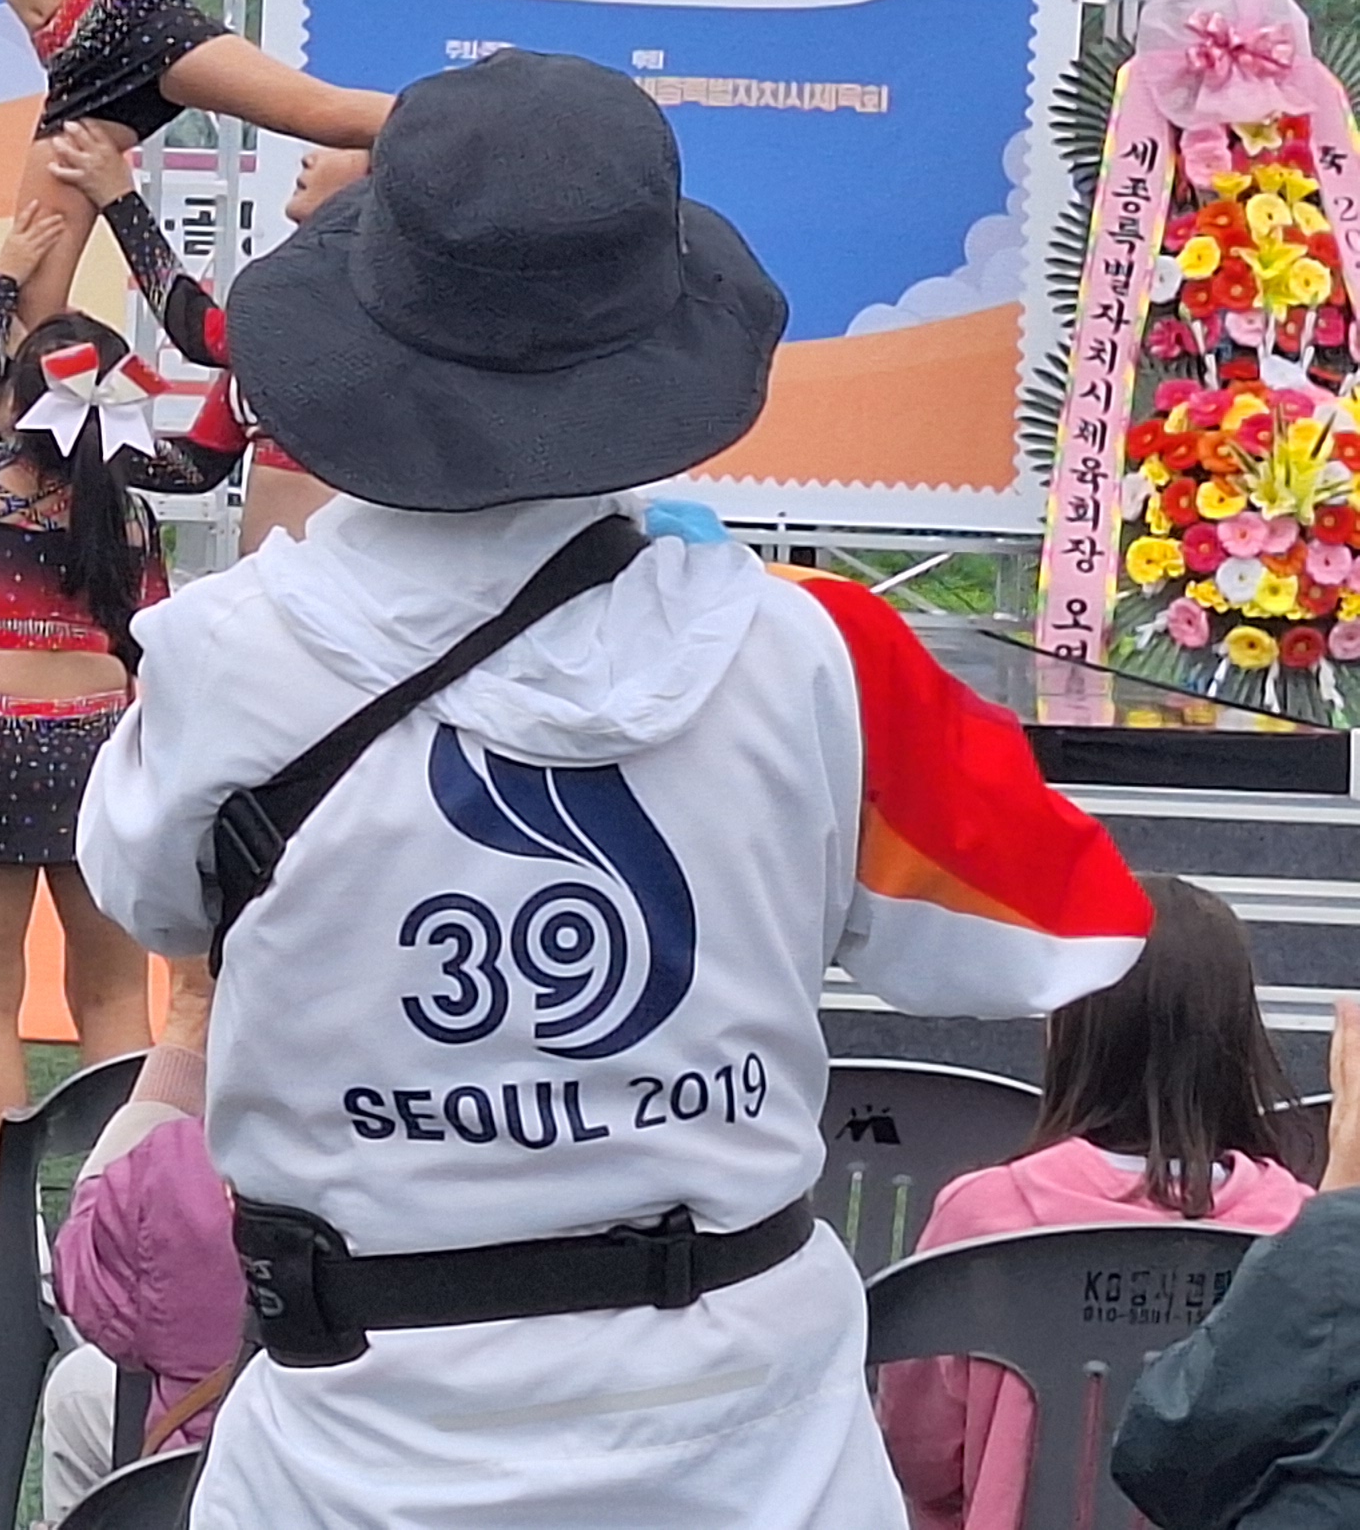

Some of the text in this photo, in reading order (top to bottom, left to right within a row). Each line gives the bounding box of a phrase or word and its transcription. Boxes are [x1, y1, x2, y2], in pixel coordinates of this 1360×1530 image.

[398, 880, 629, 1046] 39
[342, 1051, 769, 1150] SEOUL 2019
